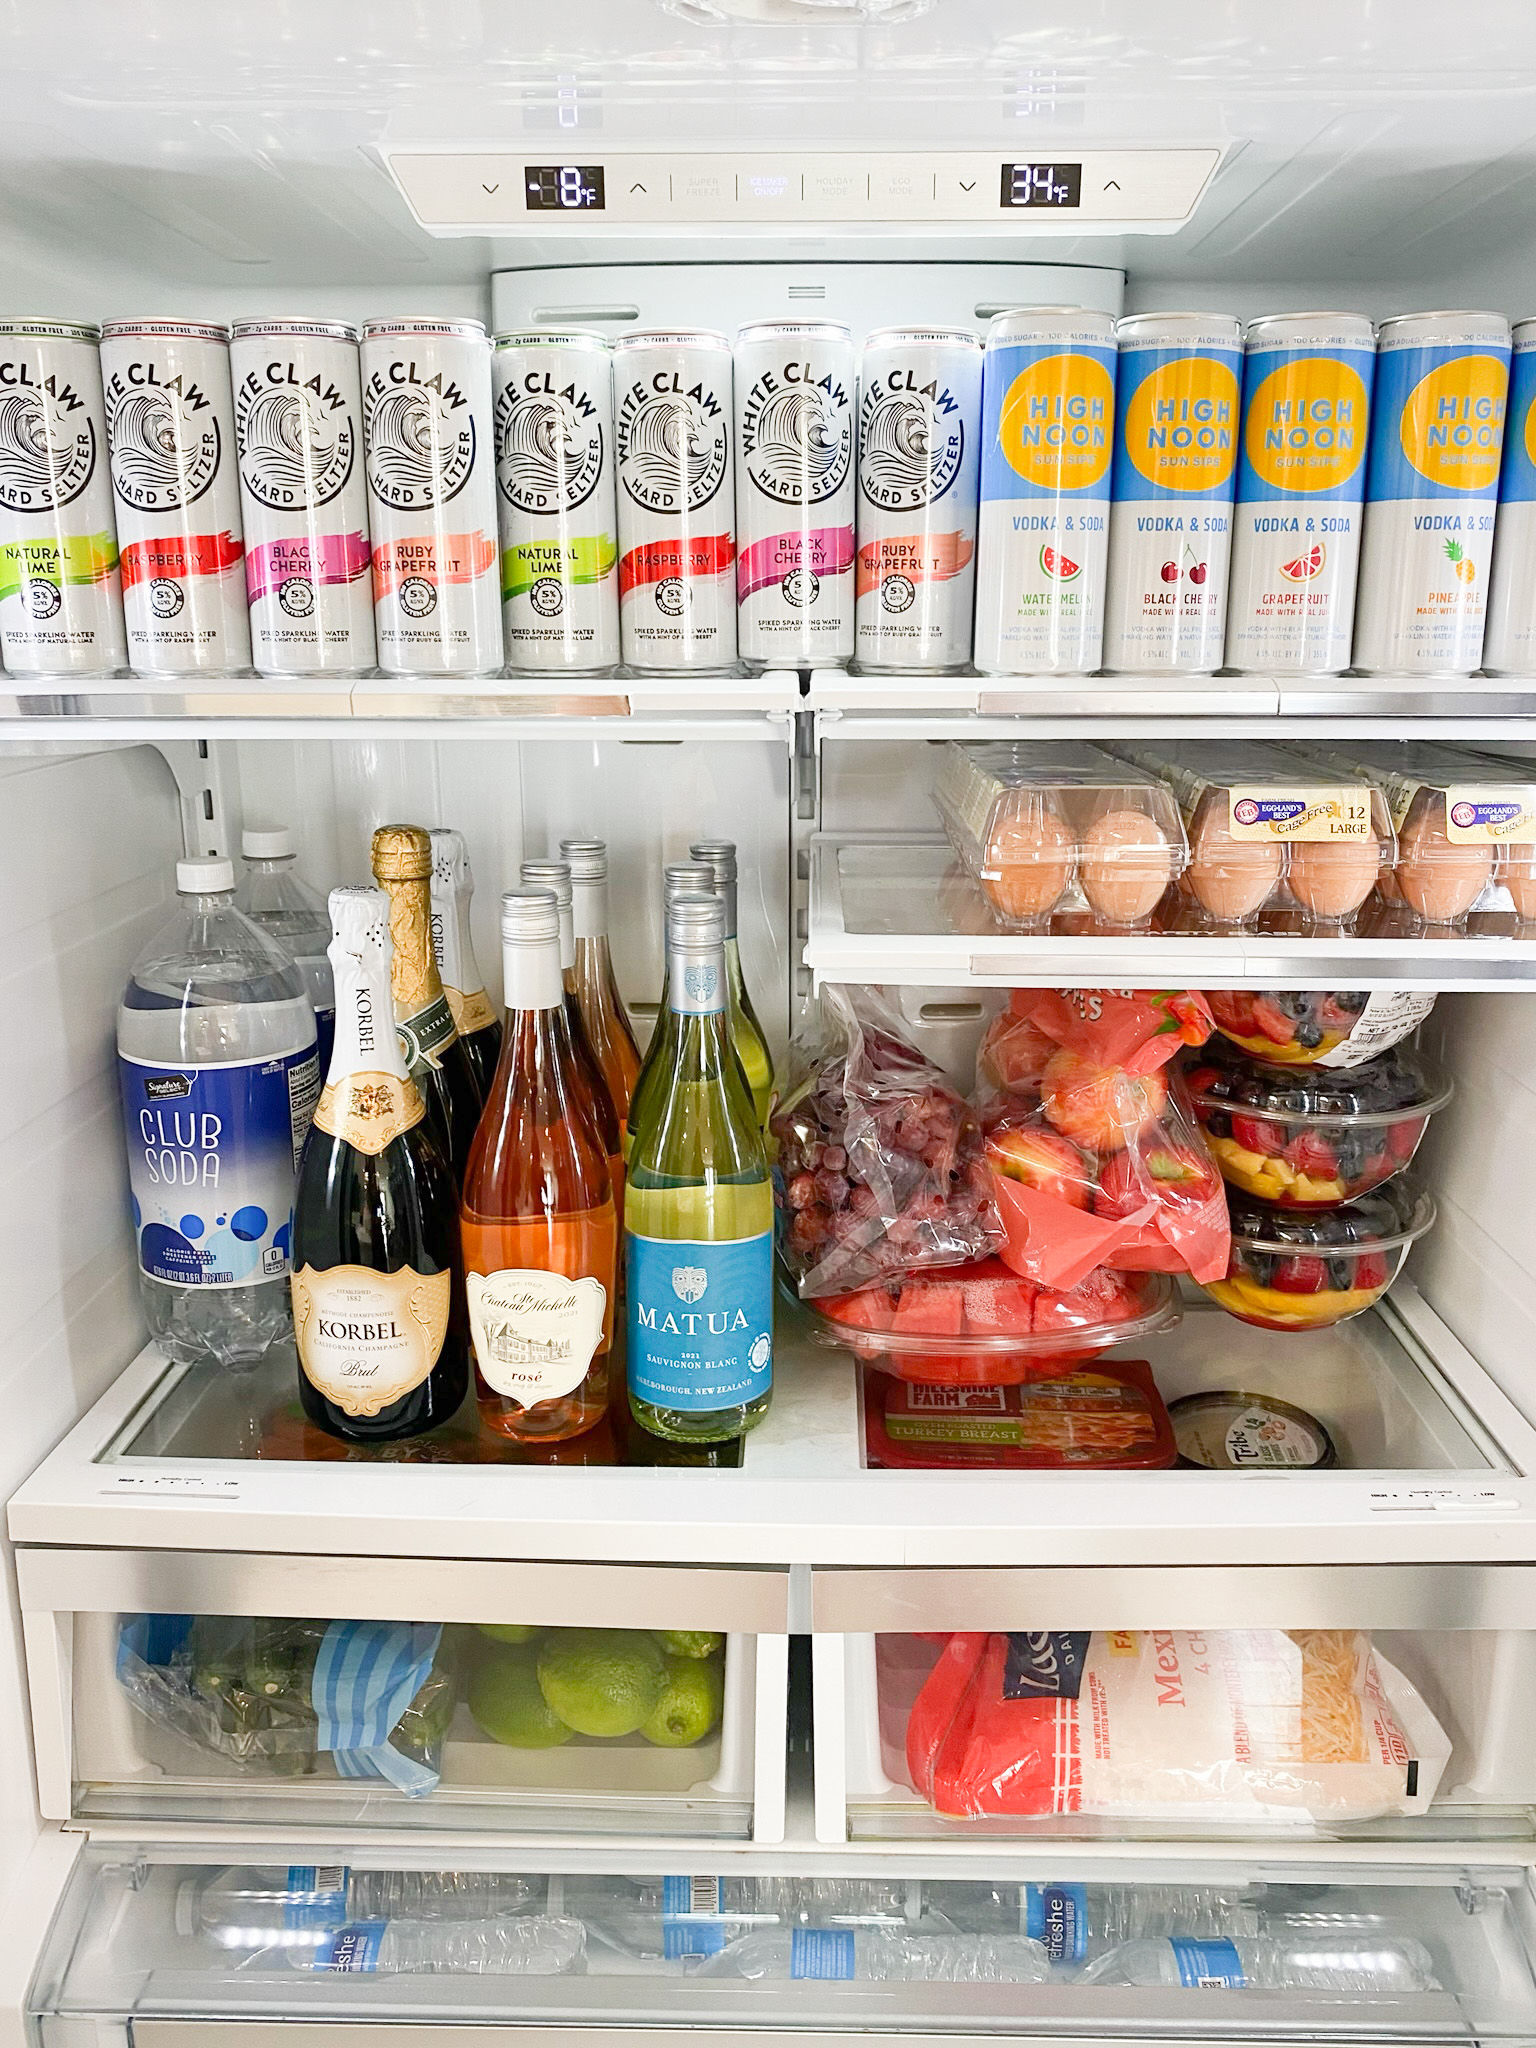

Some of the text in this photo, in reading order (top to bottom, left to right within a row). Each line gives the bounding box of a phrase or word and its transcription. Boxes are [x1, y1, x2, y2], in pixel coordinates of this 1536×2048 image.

[127, 361, 212, 413] CLAW
[388, 361, 469, 410] CLAW
[236, 361, 347, 460] WHITE CLAW
[743, 361, 850, 458] WHITE CLAW
[1028, 395, 1105, 420] HIGH
[1156, 397, 1231, 424] HIGH
[1272, 398, 1354, 424] HIGH
[493, 372, 598, 467] WHITE CLAW
[617, 371, 723, 468] WHITE CLAW
[858, 369, 960, 465] WHITE CLAW
[1021, 423, 1106, 449] NOON
[1146, 426, 1233, 450] NOON
[1264, 426, 1355, 450] NOON
[757, 428, 850, 498] HARD SELTZER
[1158, 455, 1222, 468] SUN SIPS
[1275, 455, 1306, 468] SUN
[0, 483, 32, 506] ARD
[117, 473, 158, 506] HARD
[250, 473, 295, 504] HARD
[373, 473, 415, 502] HARD
[505, 478, 548, 507] HARD
[631, 477, 675, 508] HARD
[865, 475, 903, 504] HARD
[1011, 515, 1105, 532] VODKA & SODA
[1137, 516, 1229, 533] VODKA & SODA
[1253, 517, 1351, 533] VODKA & SODA
[1413, 515, 1463, 532] VODKA
[1466, 515, 1476, 531] &
[5, 547, 72, 560] NATURAL
[396, 545, 434, 558] RUBY
[778, 538, 823, 551] BLACK
[880, 544, 917, 558] RUBY
[20, 561, 57, 575] LIME
[269, 559, 328, 573] CHERY
[379, 559, 461, 573] GRAPEFRIT
[531, 560, 563, 574] LIME
[863, 558, 941, 571] GRAPEFRUT
[1021, 592, 1091, 605] WATEMEL
[1183, 592, 1218, 605] CHERY
[1427, 591, 1481, 604] PINEPLE
[1272, 811, 1291, 819] BEST
[1276, 802, 1334, 834] Cage Free
[1347, 806, 1366, 820] 12
[1489, 814, 1507, 822] BEST
[1330, 823, 1368, 835] LARGE
[355, 987, 376, 1057] KORBEL
[419, 1016, 446, 1037] EXTRA
[147, 1080, 182, 1096] Signature
[138, 1108, 223, 1151] CLUB
[144, 1147, 222, 1189] SODA
[164, 1256, 194, 1265] CAFFEINE
[271, 1250, 277, 1261] 0
[216, 1271, 233, 1283] LITER
[480, 1288, 525, 1312] Chateau
[519, 1295, 579, 1316] Michelle
[637, 1302, 750, 1336] MATUA
[318, 1319, 402, 1341] KORBEL
[358, 1341, 410, 1353] CHAMPAGNE
[339, 1359, 380, 1377] Brut
[646, 1353, 738, 1370] SAUVIGNON BLANC
[511, 1370, 543, 1383] rosé
[695, 1386, 715, 1396] NEW
[716, 1378, 753, 1395] ZEALAND
[913, 1393, 960, 1406] FARM
[894, 1426, 1020, 1440] TURKEY BREAST
[1227, 1429, 1260, 1463] Tribe
[1373, 1719, 1385, 1737] CUP
[1382, 1748, 1392, 1766] PER
[1391, 1739, 1407, 1762] 110
